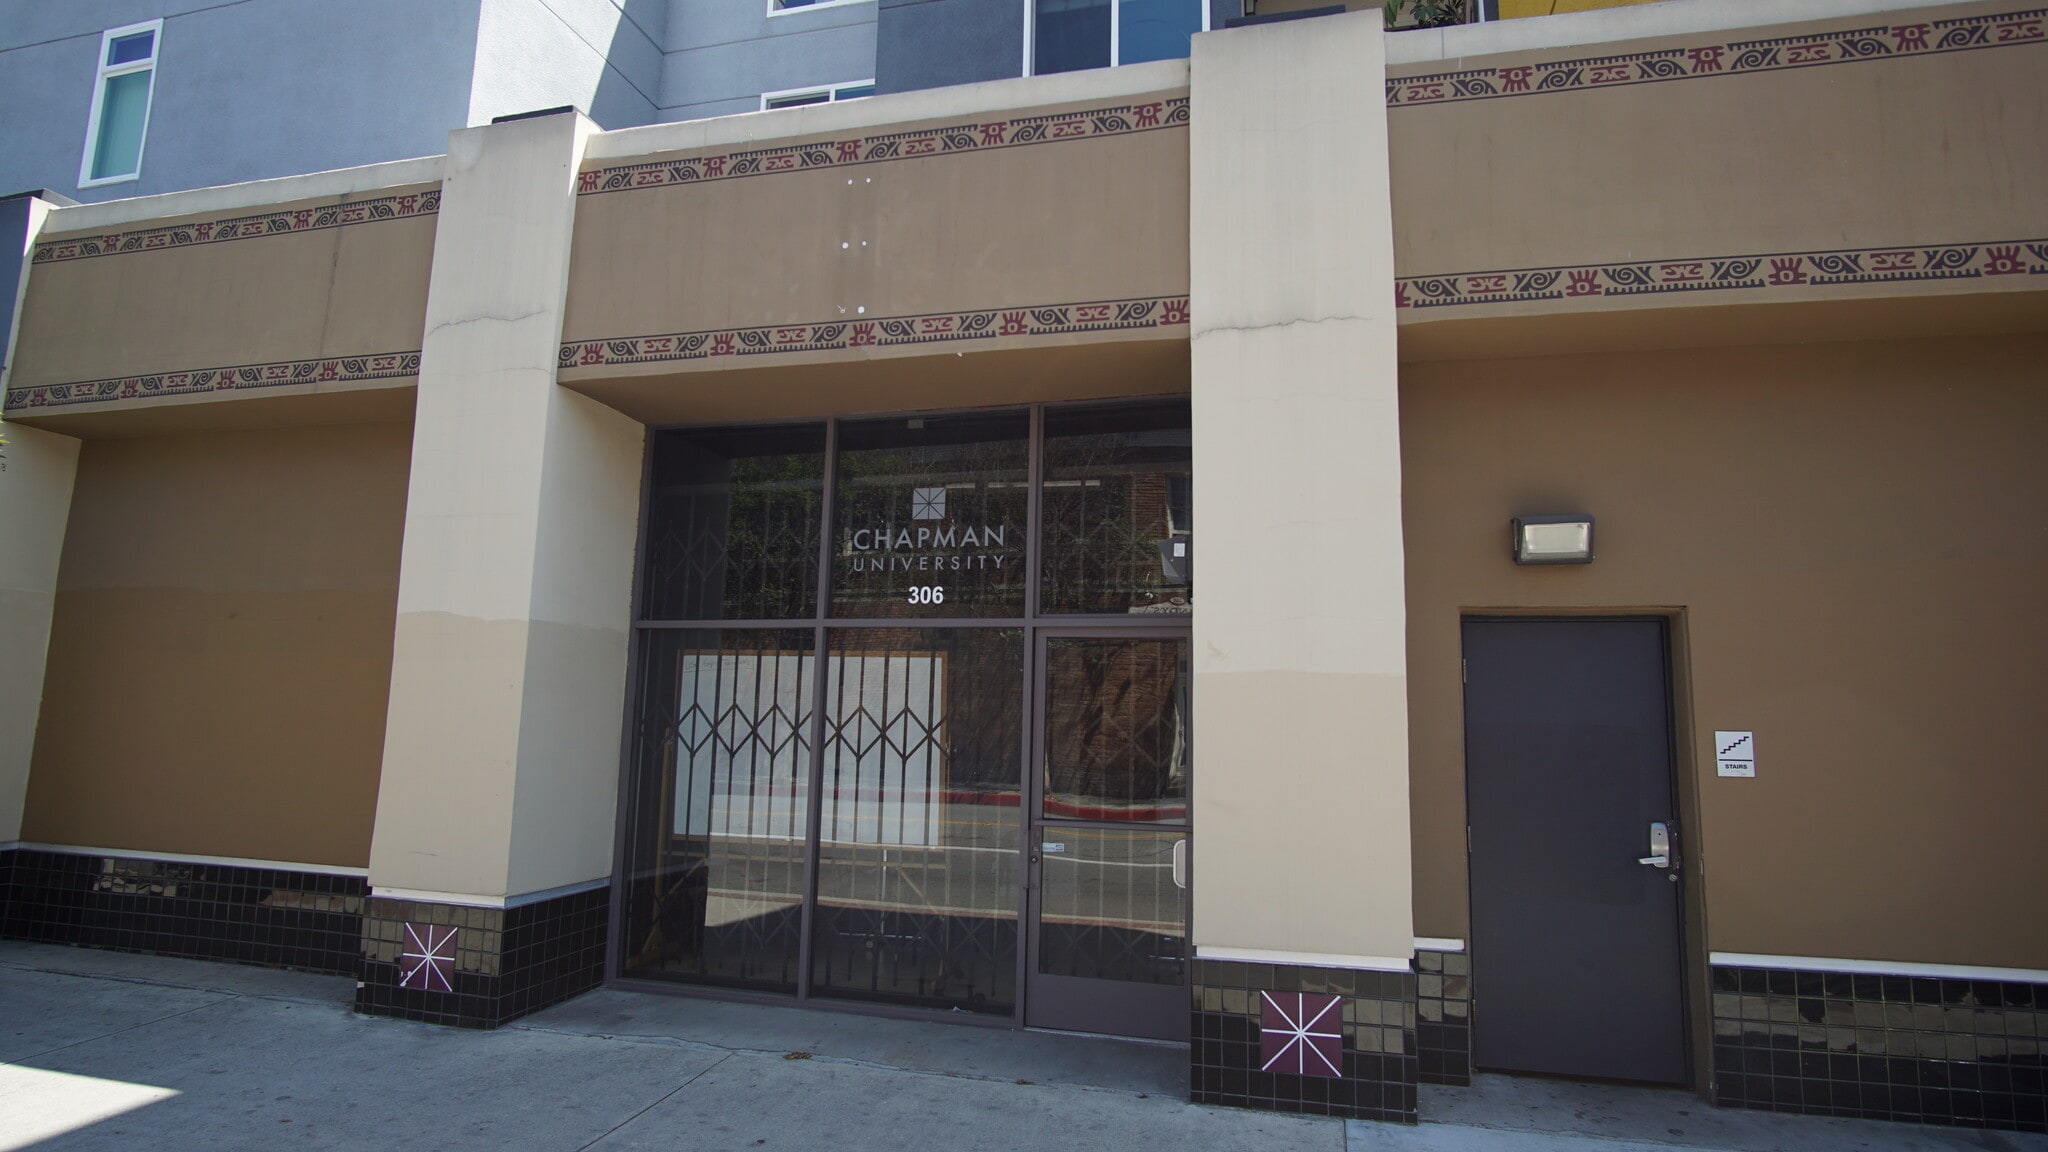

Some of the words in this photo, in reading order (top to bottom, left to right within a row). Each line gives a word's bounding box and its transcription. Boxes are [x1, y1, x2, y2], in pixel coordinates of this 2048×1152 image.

[853, 525, 1005, 550] CHAPMAN
[853, 555, 1005, 572] UNIVERSITY
[907, 586, 944, 605] 306
